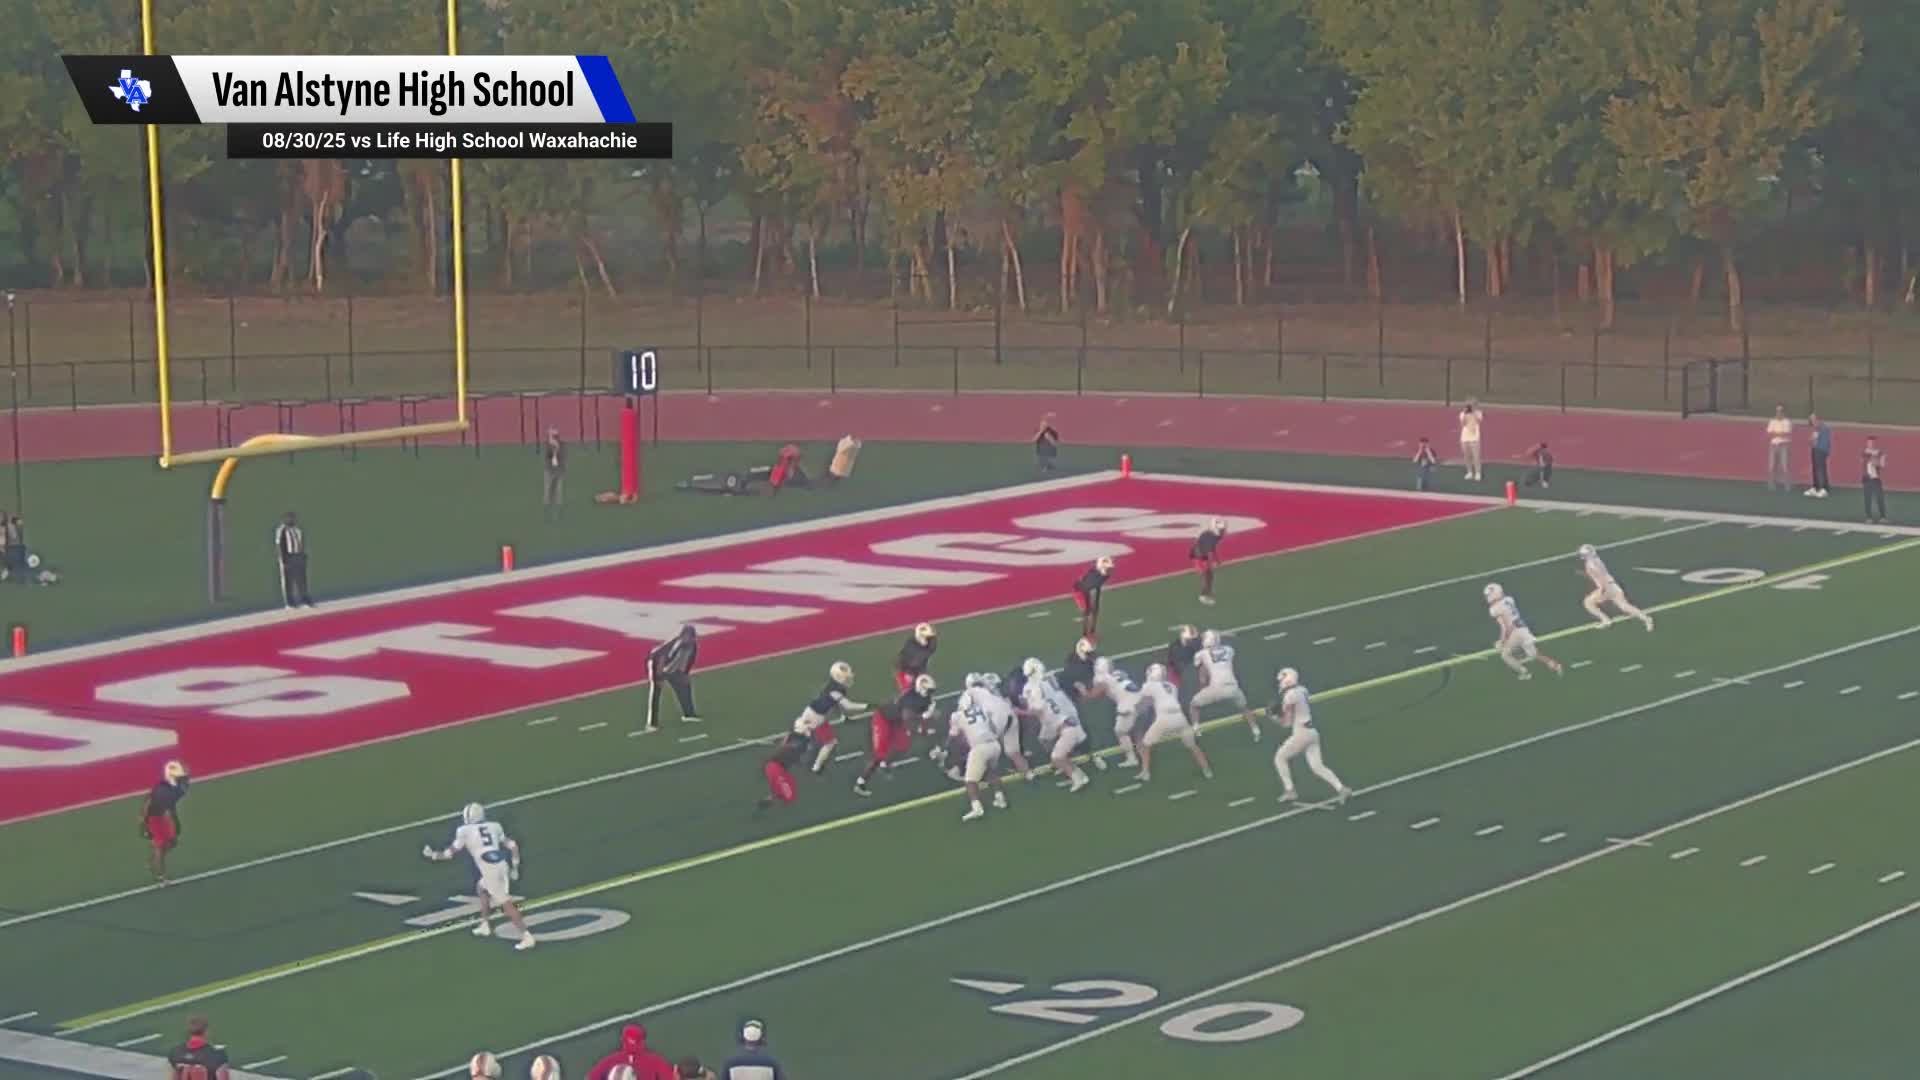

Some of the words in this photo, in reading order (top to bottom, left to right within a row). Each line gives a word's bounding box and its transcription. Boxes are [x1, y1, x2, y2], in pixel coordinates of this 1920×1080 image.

[631, 351, 656, 390] 10
[477, 826, 493, 846] 5
[990, 979, 1305, 1042] 20
